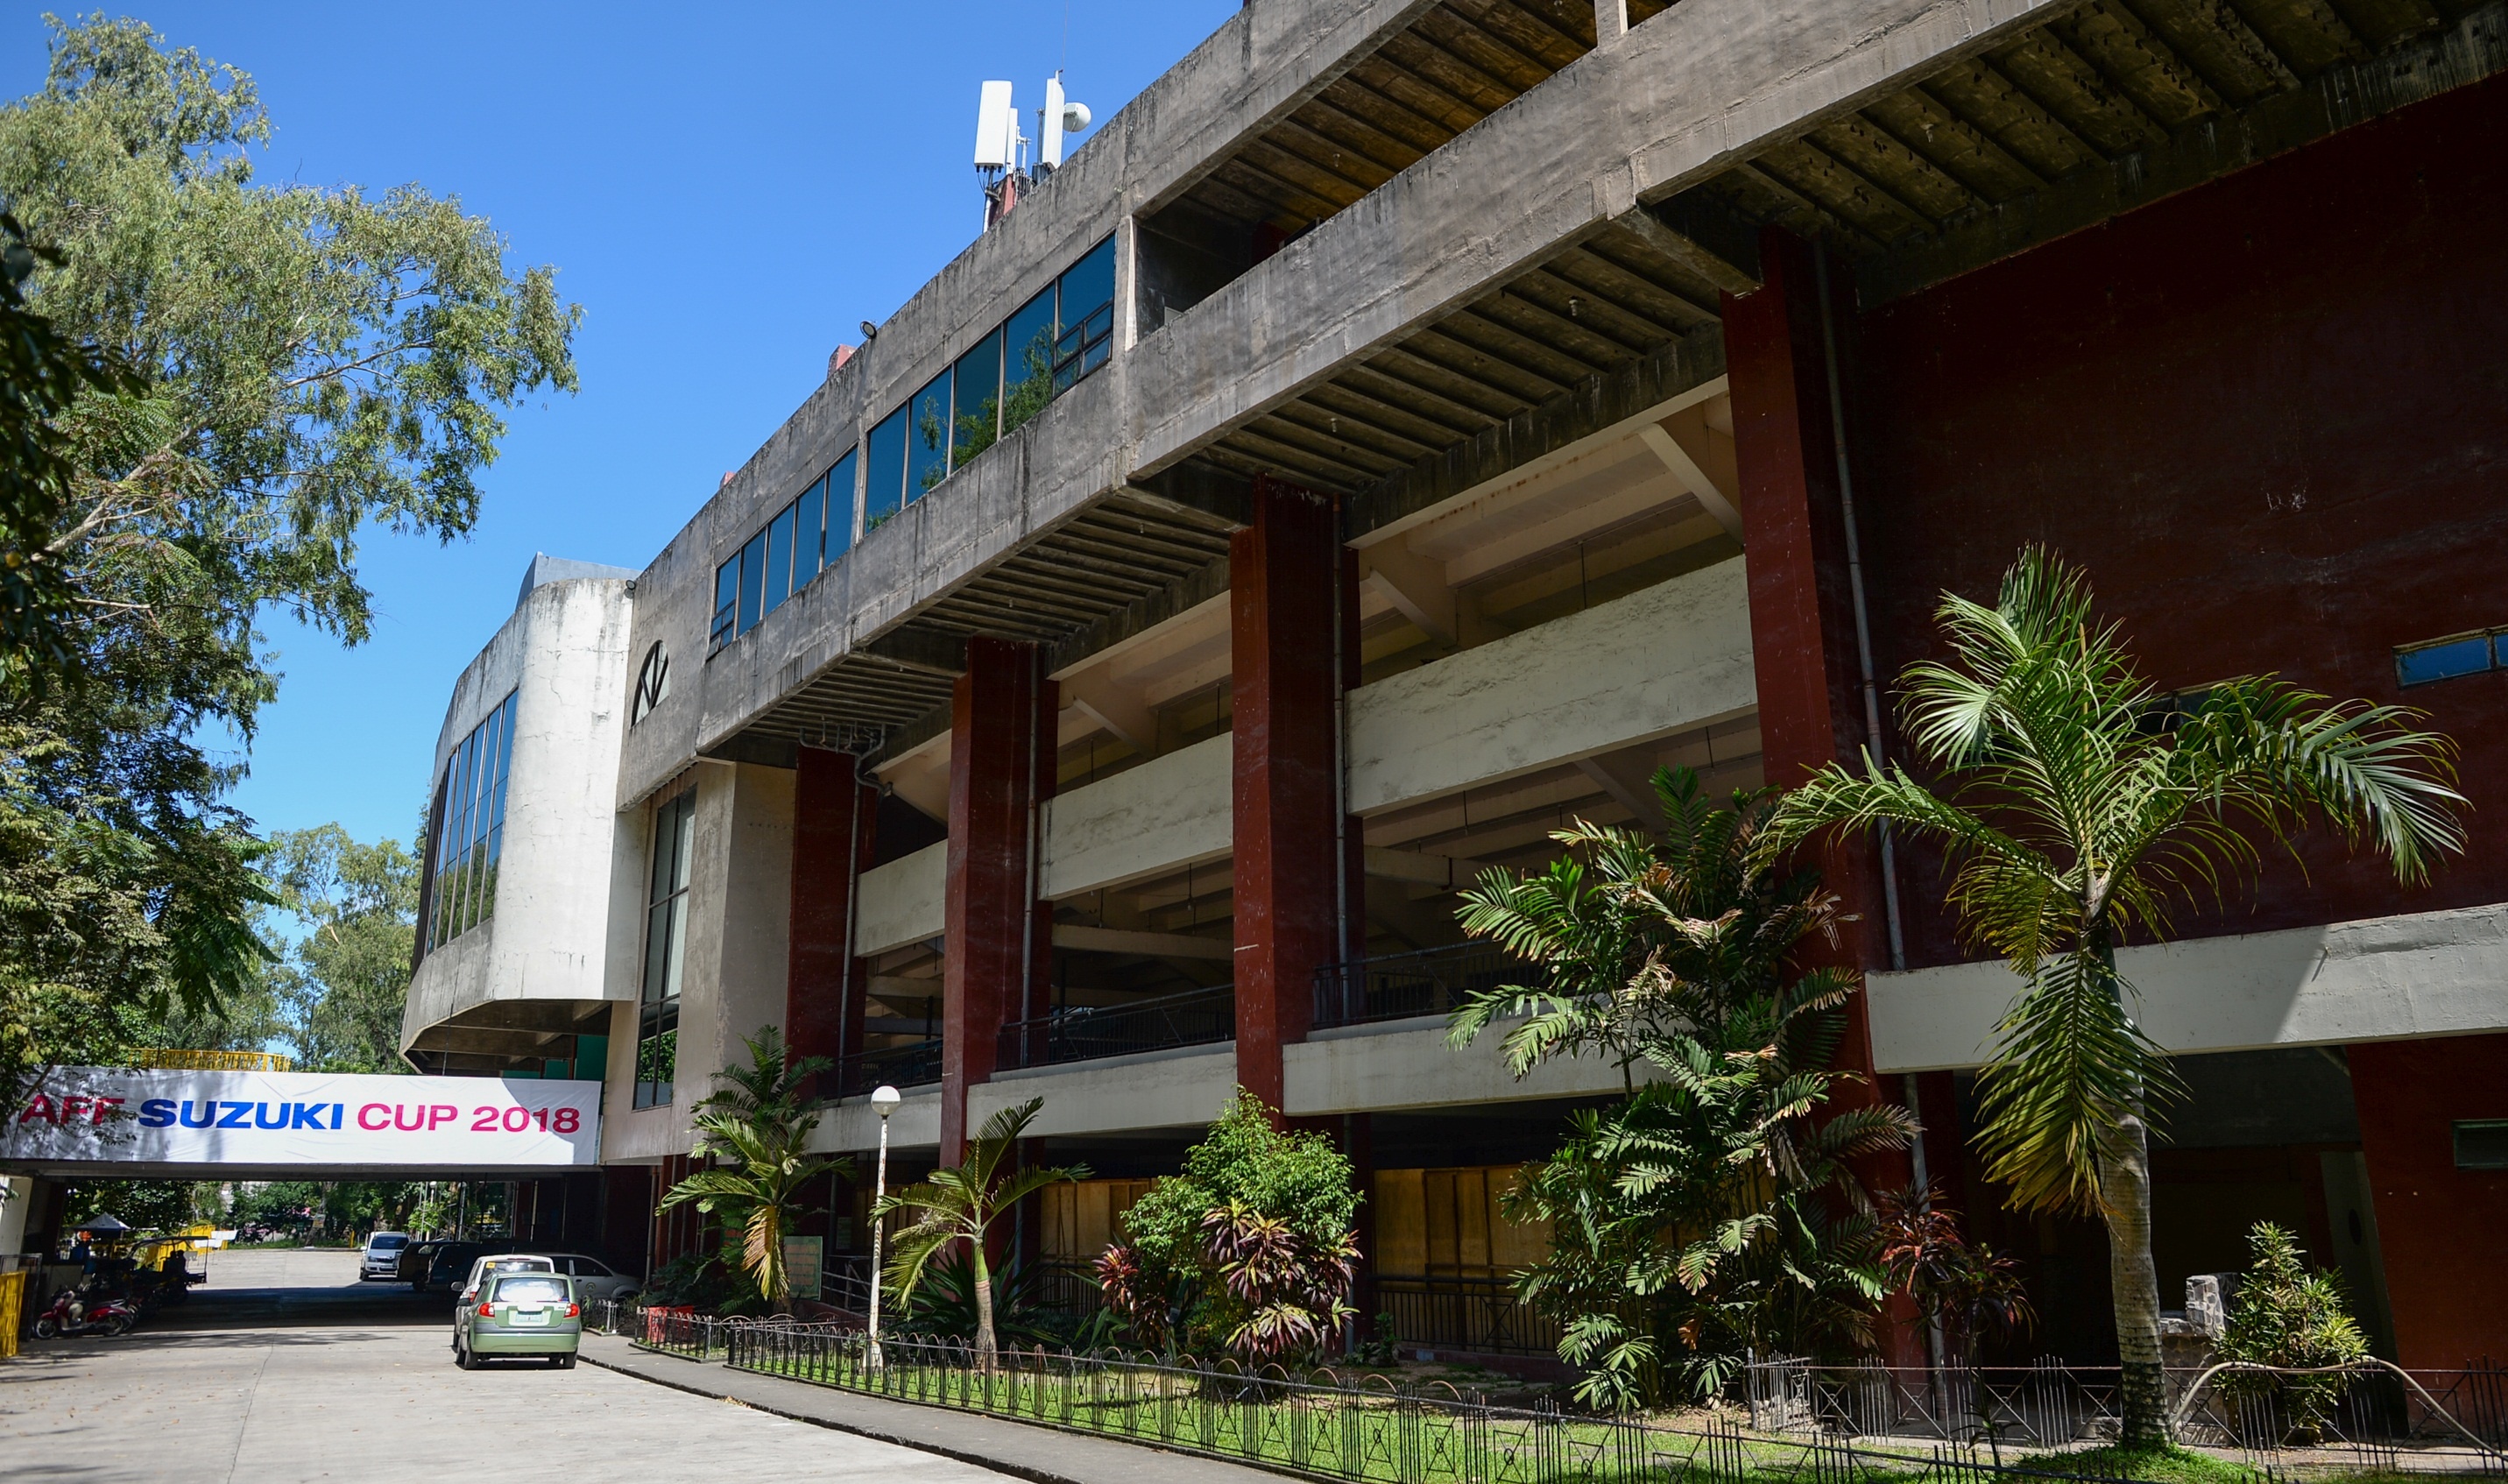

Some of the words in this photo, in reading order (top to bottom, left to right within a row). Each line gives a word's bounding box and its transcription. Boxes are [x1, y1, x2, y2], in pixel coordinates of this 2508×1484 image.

[20, 1094, 125, 1126] AFF
[139, 1099, 343, 1129] SUZUKI
[358, 1103, 457, 1131] CUP
[471, 1106, 581, 1134] 2018
